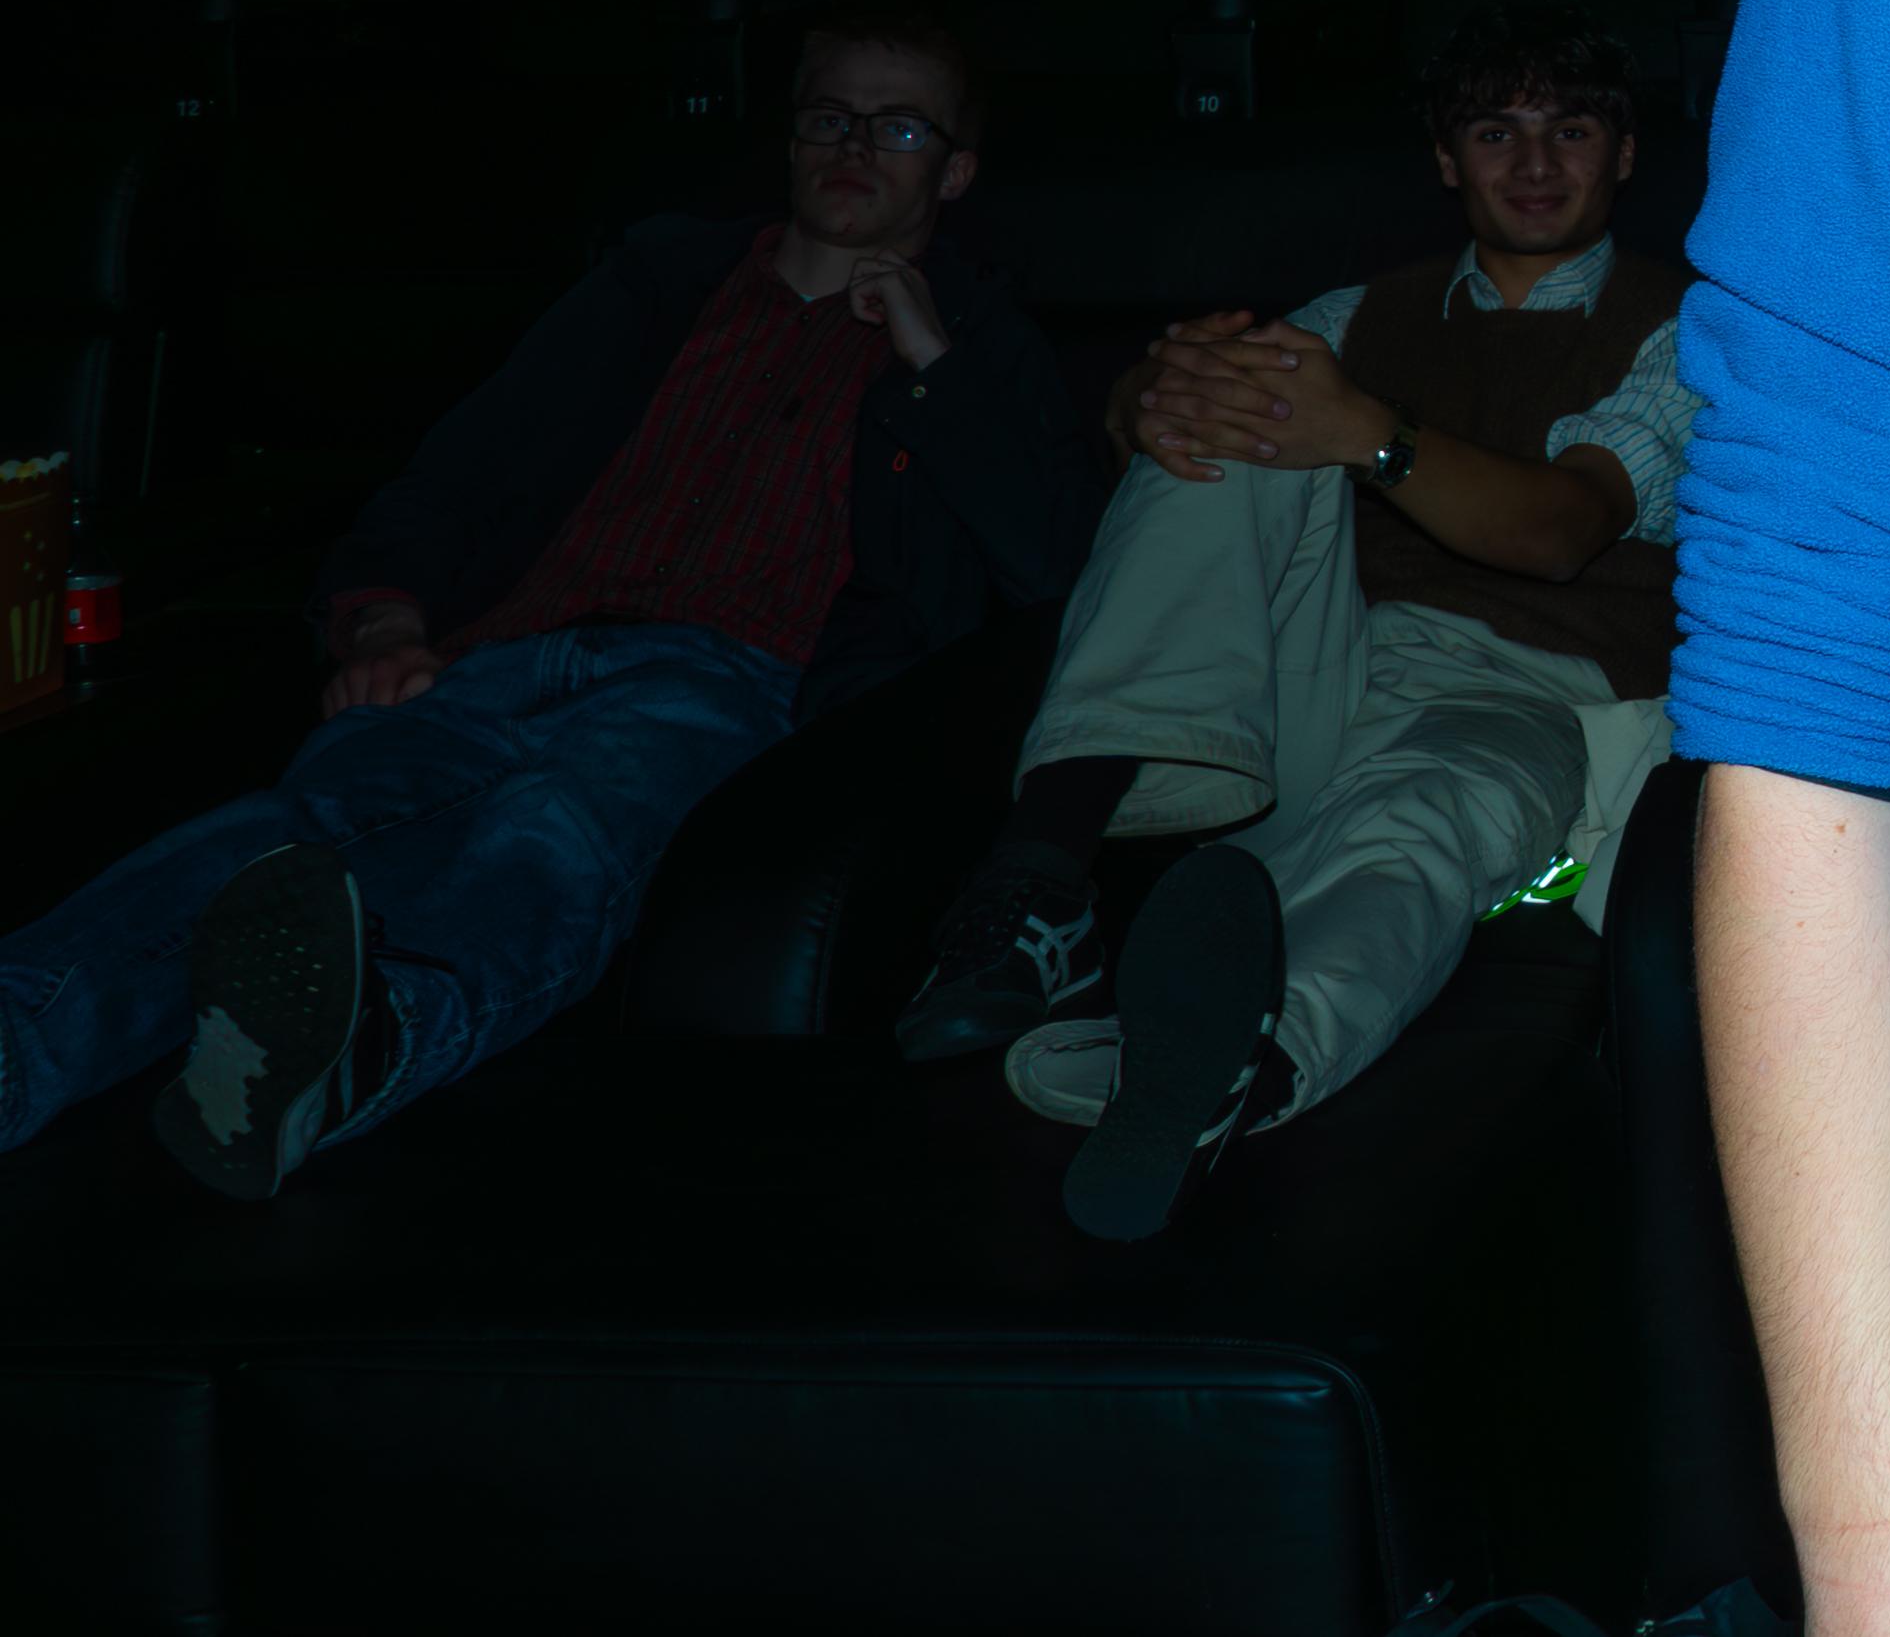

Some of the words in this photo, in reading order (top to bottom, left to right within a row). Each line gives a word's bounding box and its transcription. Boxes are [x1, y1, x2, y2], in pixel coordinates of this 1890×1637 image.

[175, 98, 201, 118] 12
[685, 96, 709, 116] 11
[1196, 95, 1220, 114] 10
